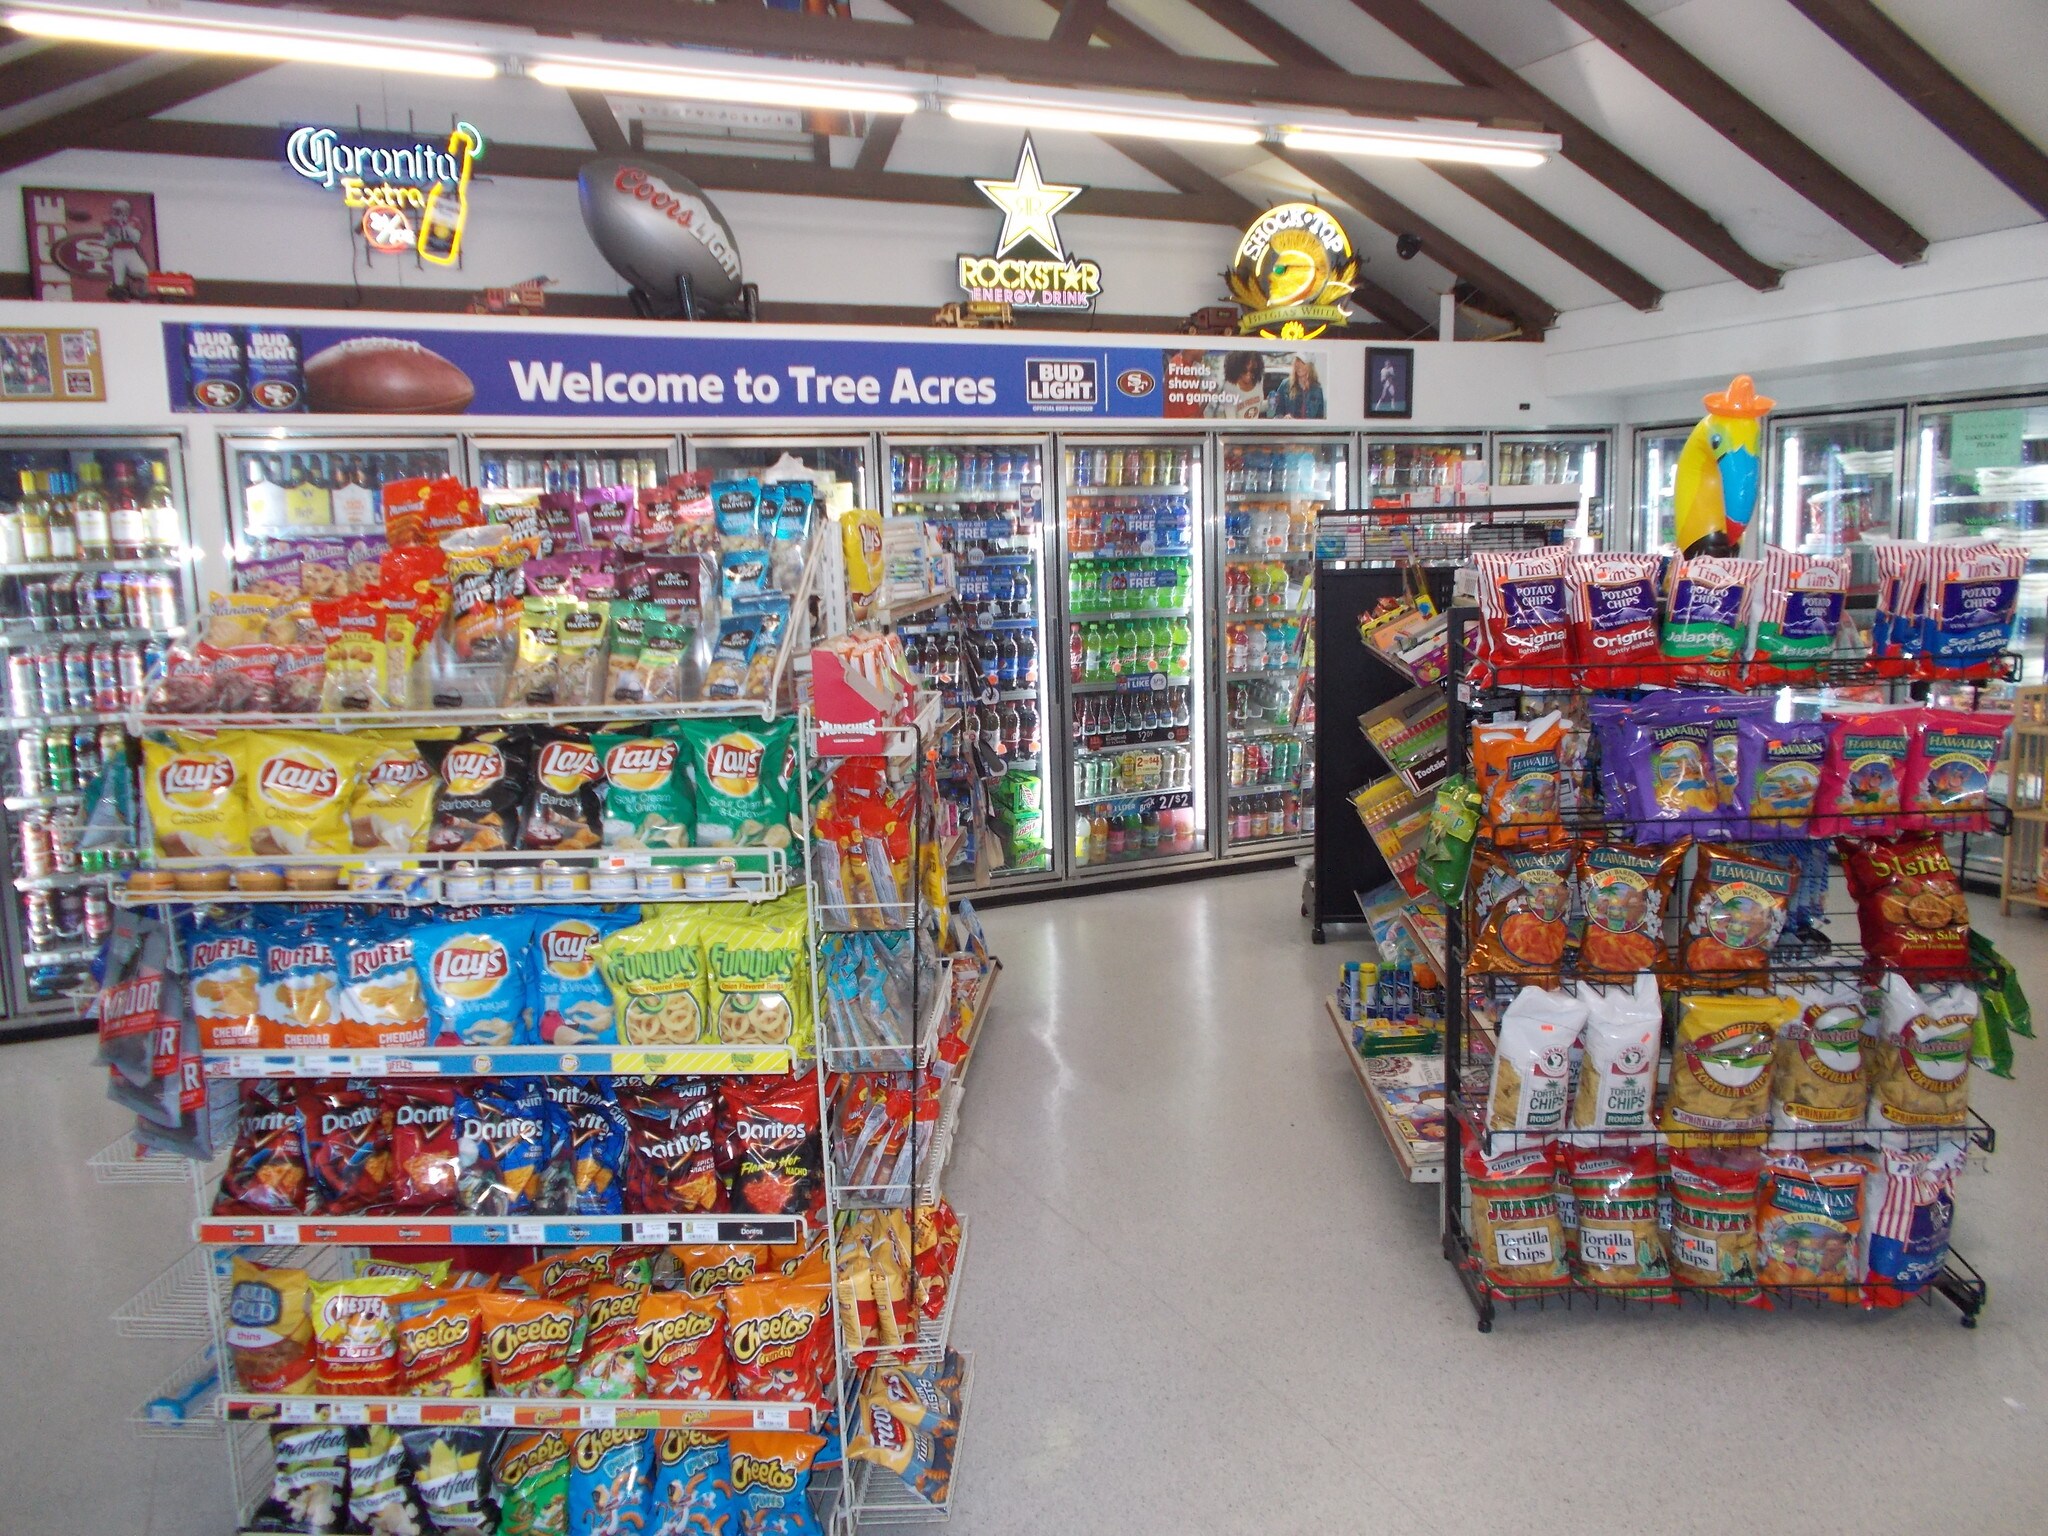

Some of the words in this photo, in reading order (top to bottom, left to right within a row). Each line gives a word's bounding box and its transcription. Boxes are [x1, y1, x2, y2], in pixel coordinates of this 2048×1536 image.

[287, 127, 459, 188] Coronita
[341, 177, 426, 208] Extra
[613, 165, 694, 228] Coors
[688, 220, 741, 281] LIGHT
[973, 287, 1036, 304] ENERGY
[1042, 290, 1088, 306] DRINK
[192, 331, 232, 346] BUD
[251, 332, 289, 347] BUD
[188, 345, 239, 360] LIGHT
[247, 346, 297, 361] LIGHT
[1039, 363, 1084, 382] BUD
[1168, 364, 1211, 376] Friends
[508, 360, 725, 403] Welcome
[735, 367, 780, 404] to
[788, 366, 880, 405] Tree
[889, 367, 997, 405] Acres
[1168, 378, 1200, 390] show
[1201, 379, 1217, 391] up
[1031, 381, 1093, 400] LIGHT
[1168, 392, 1184, 403] on
[1185, 391, 1242, 405] gameday.
[957, 527, 987, 538] FREE
[1129, 521, 1156, 531] FREE
[1516, 561, 1552, 577] Tim's
[1967, 562, 2001, 577] Tim's
[960, 583, 989, 593] FREE
[1129, 578, 1156, 587] FREE
[1805, 574, 1835, 588] Tim's
[1516, 586, 1556, 597] POTATO
[1601, 586, 1642, 600] POTATO
[1961, 587, 2001, 598] POTATO
[1521, 595, 1554, 606] CHIPS
[1606, 598, 1640, 609] CHIPS
[1802, 598, 1832, 607] POTATO
[1964, 598, 1997, 608] CHIPS
[1804, 608, 1828, 617] CHIPS
[1506, 629, 1567, 648] Original
[1949, 636, 1978, 648] Sea
[1979, 630, 2002, 642] Salt
[1541, 642, 1561, 651] salted
[1607, 645, 1630, 656] lightly
[1631, 641, 1654, 651] salted
[1956, 639, 2009, 654] Vinegar
[1132, 679, 1149, 688] LIKE
[819, 719, 876, 738] MUNCHIES
[1654, 726, 1708, 741] HAWAIIAN
[1849, 738, 1906, 750] HAWAIIAN
[1929, 736, 1995, 751] HAWAIIAN
[448, 753, 499, 781] Lay's
[543, 745, 600, 777] Lay's
[611, 744, 676, 775] Lay's
[712, 745, 762, 779] Lay's
[166, 759, 232, 793] Lay's
[1415, 759, 1446, 779] Tootsie
[262, 759, 336, 795] Lay's
[438, 799, 492, 812] Barbecue
[615, 794, 637, 803] Sour
[640, 793, 672, 802] Cream
[709, 796, 734, 807] Sour
[1159, 794, 1189, 810] 2/$2
[635, 803, 662, 812] Onion
[170, 810, 226, 825] Classic
[1715, 865, 1785, 887] HAWAIIAN
[269, 944, 336, 975] RUFFLE
[438, 949, 504, 984] Lay's
[608, 944, 700, 986] FUNYUNS
[711, 942, 797, 983] FUNYUNS
[212, 1027, 260, 1039] CHEDDAR
[284, 1033, 331, 1045] CHEDDAR
[379, 1029, 426, 1044] CHEDDAR
[1532, 1085, 1567, 1098] TORTILLA
[1610, 1086, 1647, 1097] TORTILLA
[1530, 1097, 1565, 1110] CHIPS
[1607, 1096, 1645, 1110] CHIPS
[397, 1104, 456, 1126] Dorito
[1608, 1113, 1641, 1123] ROUNDS
[464, 1117, 544, 1141] Doritos
[736, 1121, 806, 1141] Doritos
[697, 1158, 714, 1167] SPICY
[1491, 1160, 1522, 1172] Gluten
[1523, 1153, 1542, 1164] Free
[1579, 1159, 1609, 1171] Gluten
[786, 1166, 808, 1176] NACHO
[1780, 1184, 1855, 1209] HWAIIAN
[740, 1226, 763, 1237] Doritos
[1497, 1231, 1549, 1247] Tortilla
[1580, 1230, 1632, 1247] Tortilla
[1504, 1248, 1546, 1262] Chips
[1586, 1246, 1628, 1262] Chips
[688, 1256, 756, 1297] Cheetos
[237, 1332, 262, 1341] thins
[403, 1316, 470, 1367] heetos
[489, 1312, 574, 1365] Cheetos
[638, 1310, 718, 1362] Cheetos
[731, 1308, 817, 1366] Cheetos
[657, 1341, 700, 1367] Crunchy
[756, 1344, 797, 1367] Crunchy
[731, 1455, 801, 1494] Cheetos
[750, 1494, 785, 1509] PUFFS
